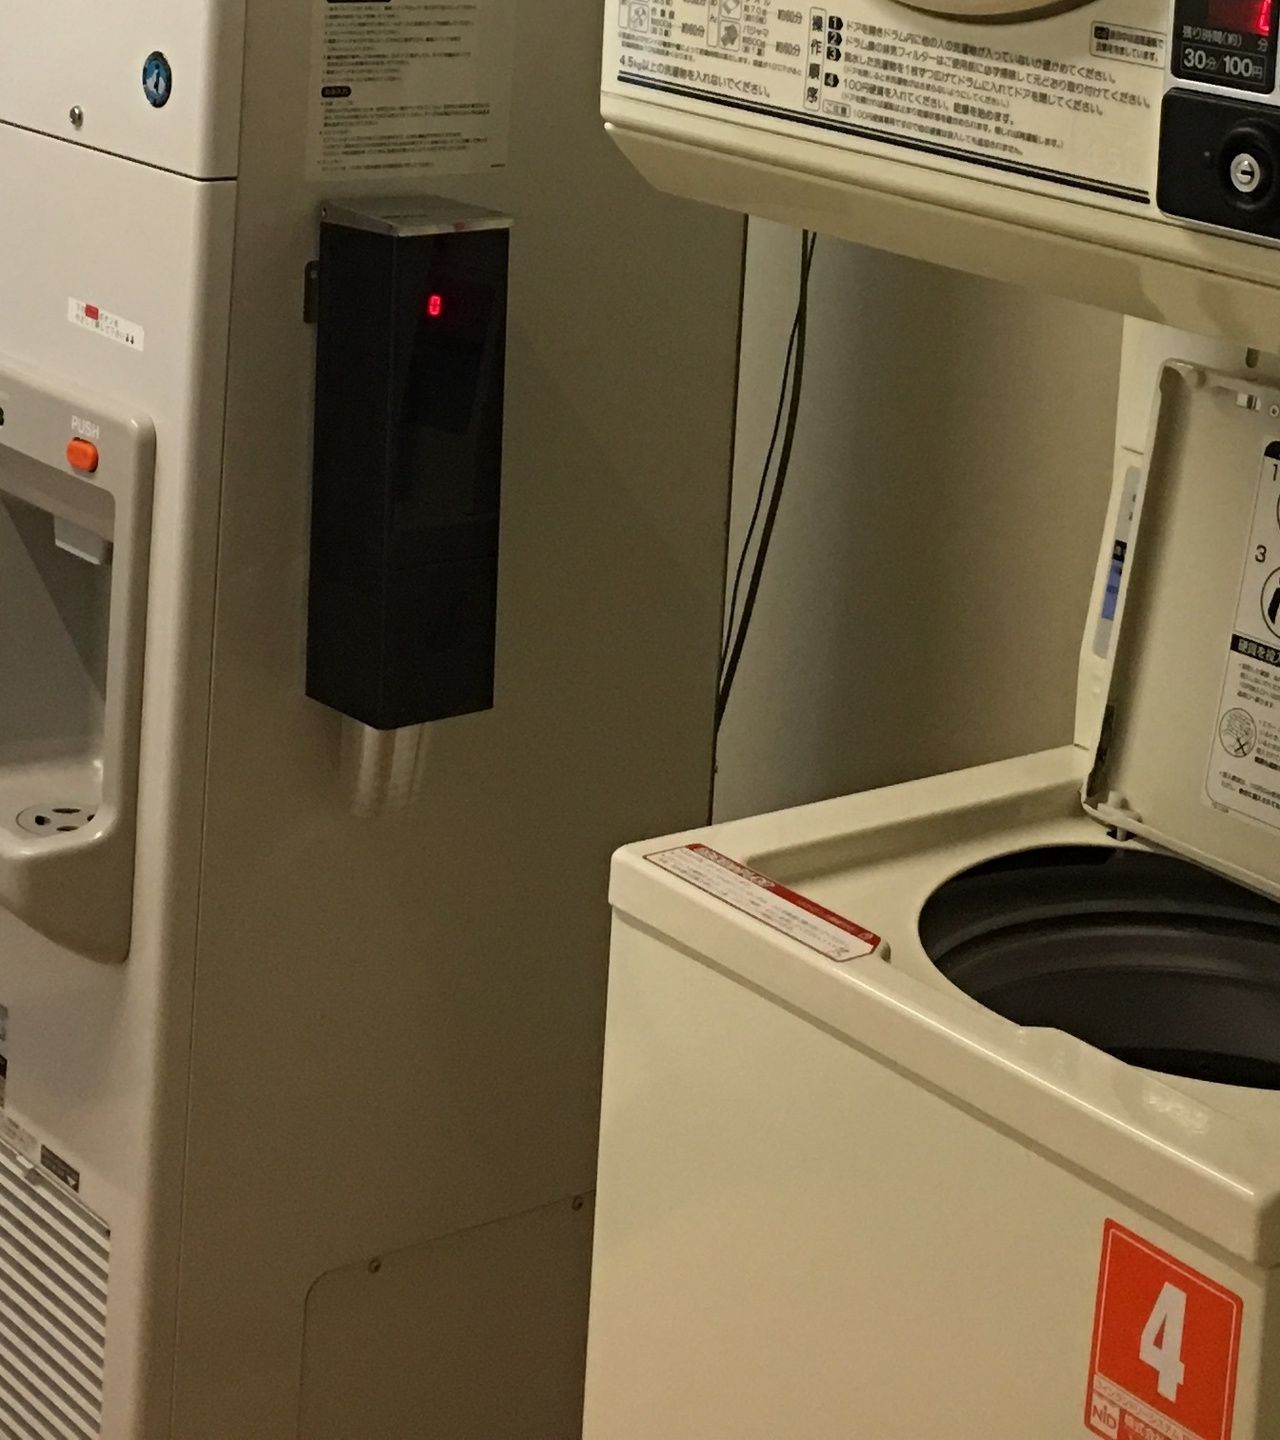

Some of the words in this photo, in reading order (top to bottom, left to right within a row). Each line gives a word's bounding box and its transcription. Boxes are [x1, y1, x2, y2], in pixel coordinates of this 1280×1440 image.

[1257, 38, 1269, 53] 分
[1183, 47, 1218, 71] 30分
[1223, 54, 1264, 80] 100円
[1272, 463, 1279, 482] 1
[1254, 544, 1268, 563] 3
[1138, 1280, 1188, 1404] 4
